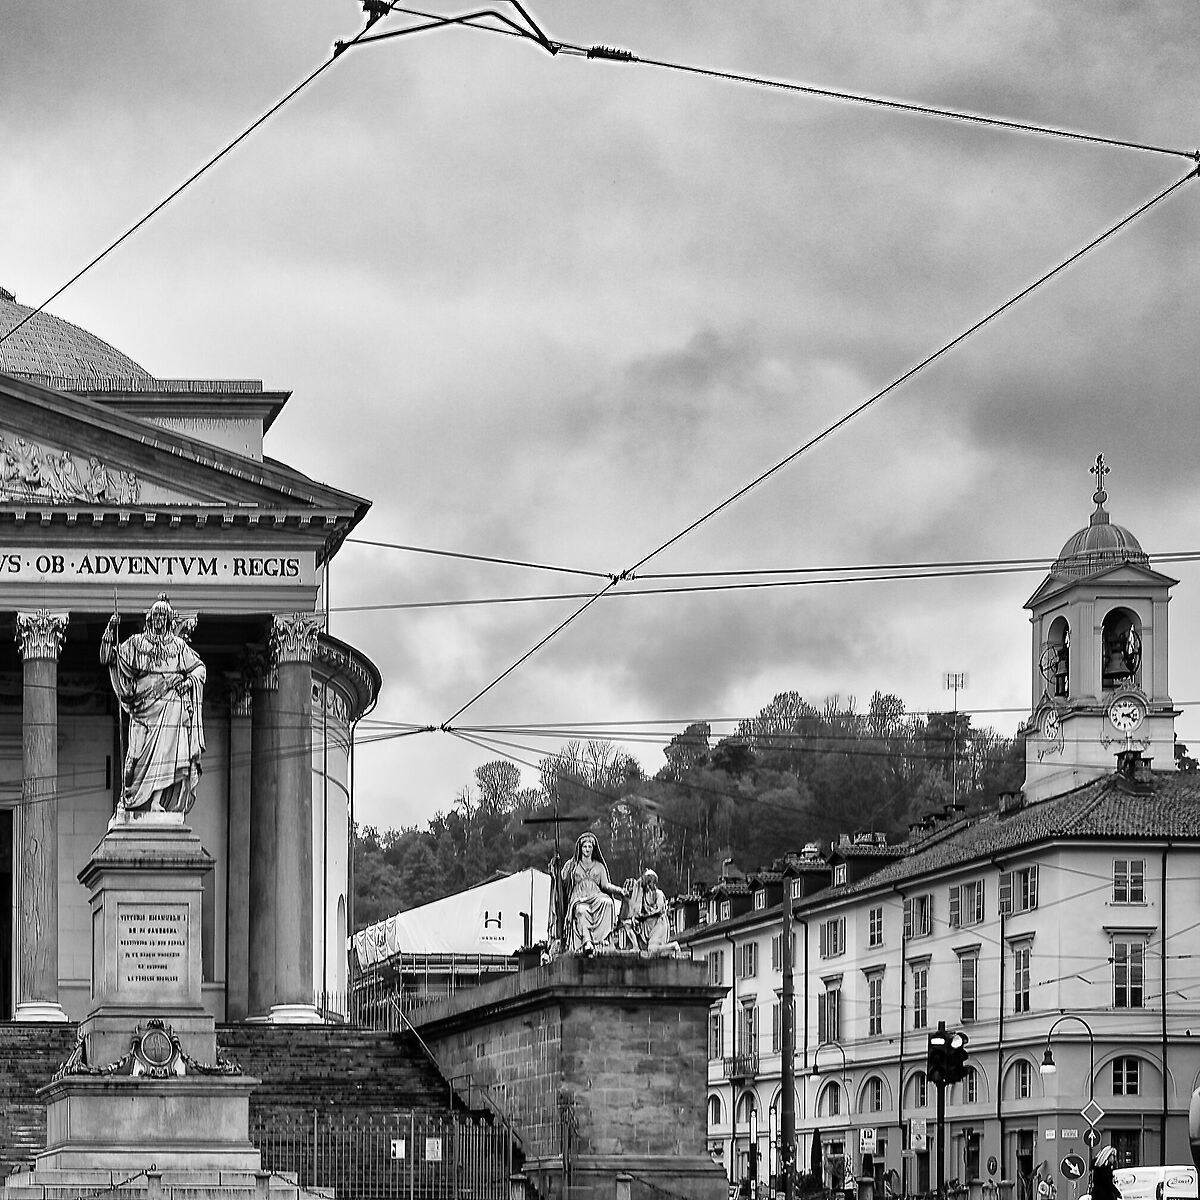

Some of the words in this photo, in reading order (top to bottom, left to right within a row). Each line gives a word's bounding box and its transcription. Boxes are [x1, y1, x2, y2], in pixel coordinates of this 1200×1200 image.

[36, 554, 65, 574] OB
[77, 554, 218, 576] ADVENTVM
[233, 557, 299, 577] REGIS
